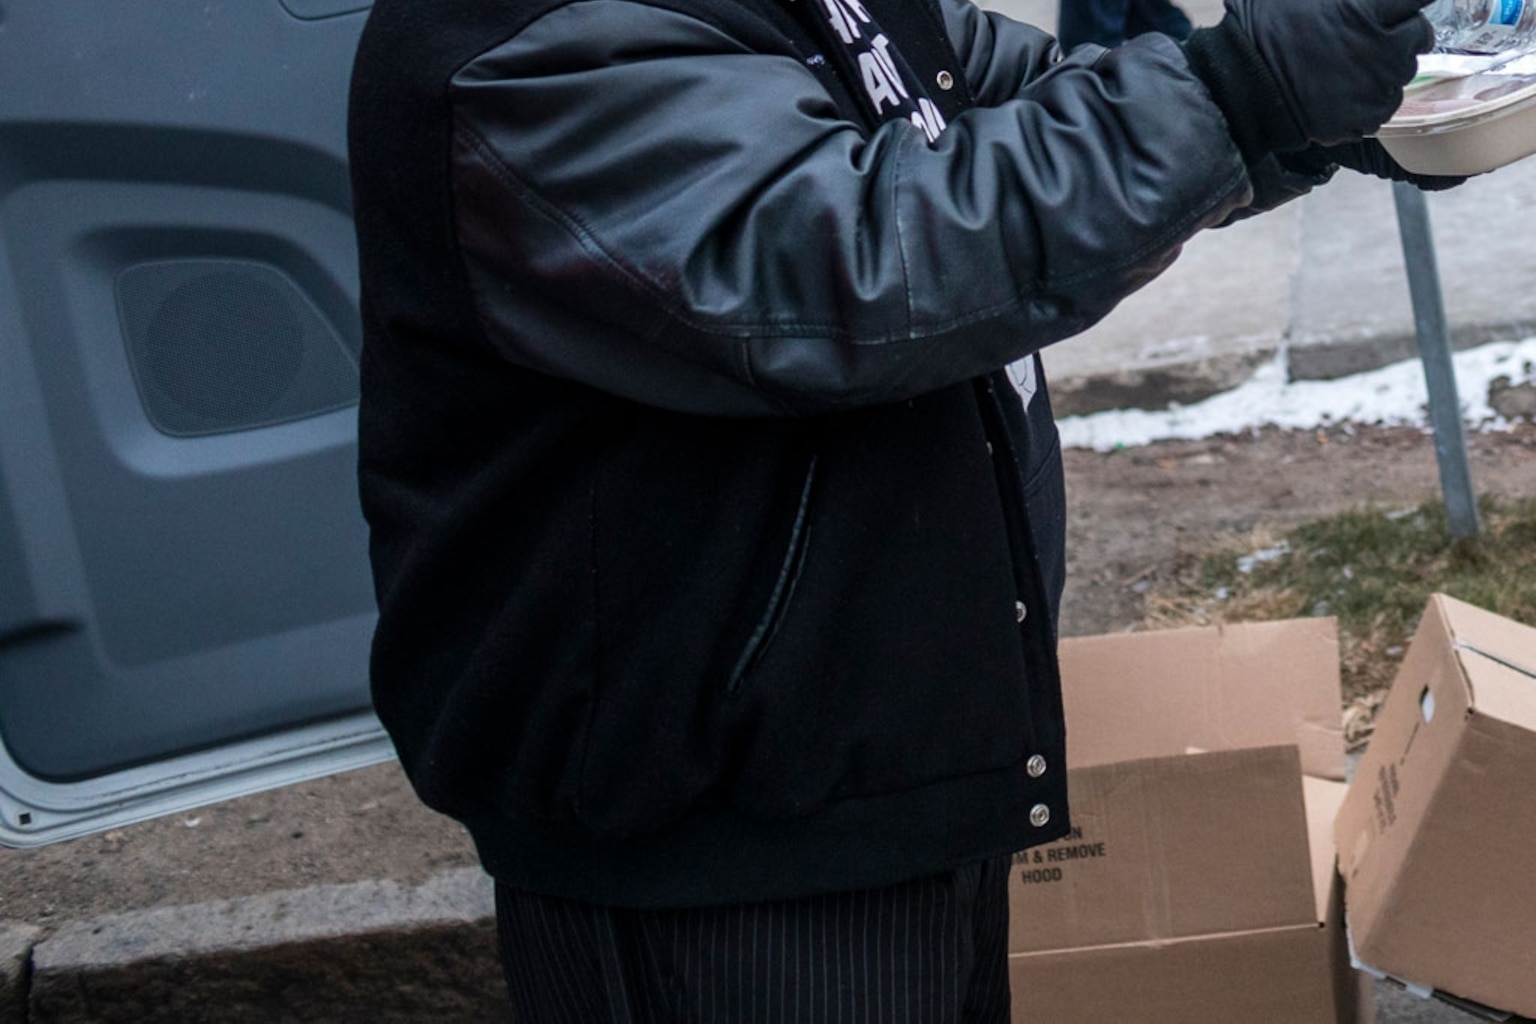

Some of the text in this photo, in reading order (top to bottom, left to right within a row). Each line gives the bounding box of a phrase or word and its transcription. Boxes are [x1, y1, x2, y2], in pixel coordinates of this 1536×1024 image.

[1032, 849, 1043, 864] &
[1047, 843, 1106, 862] REMOVE
[1022, 867, 1063, 884] HOOD
